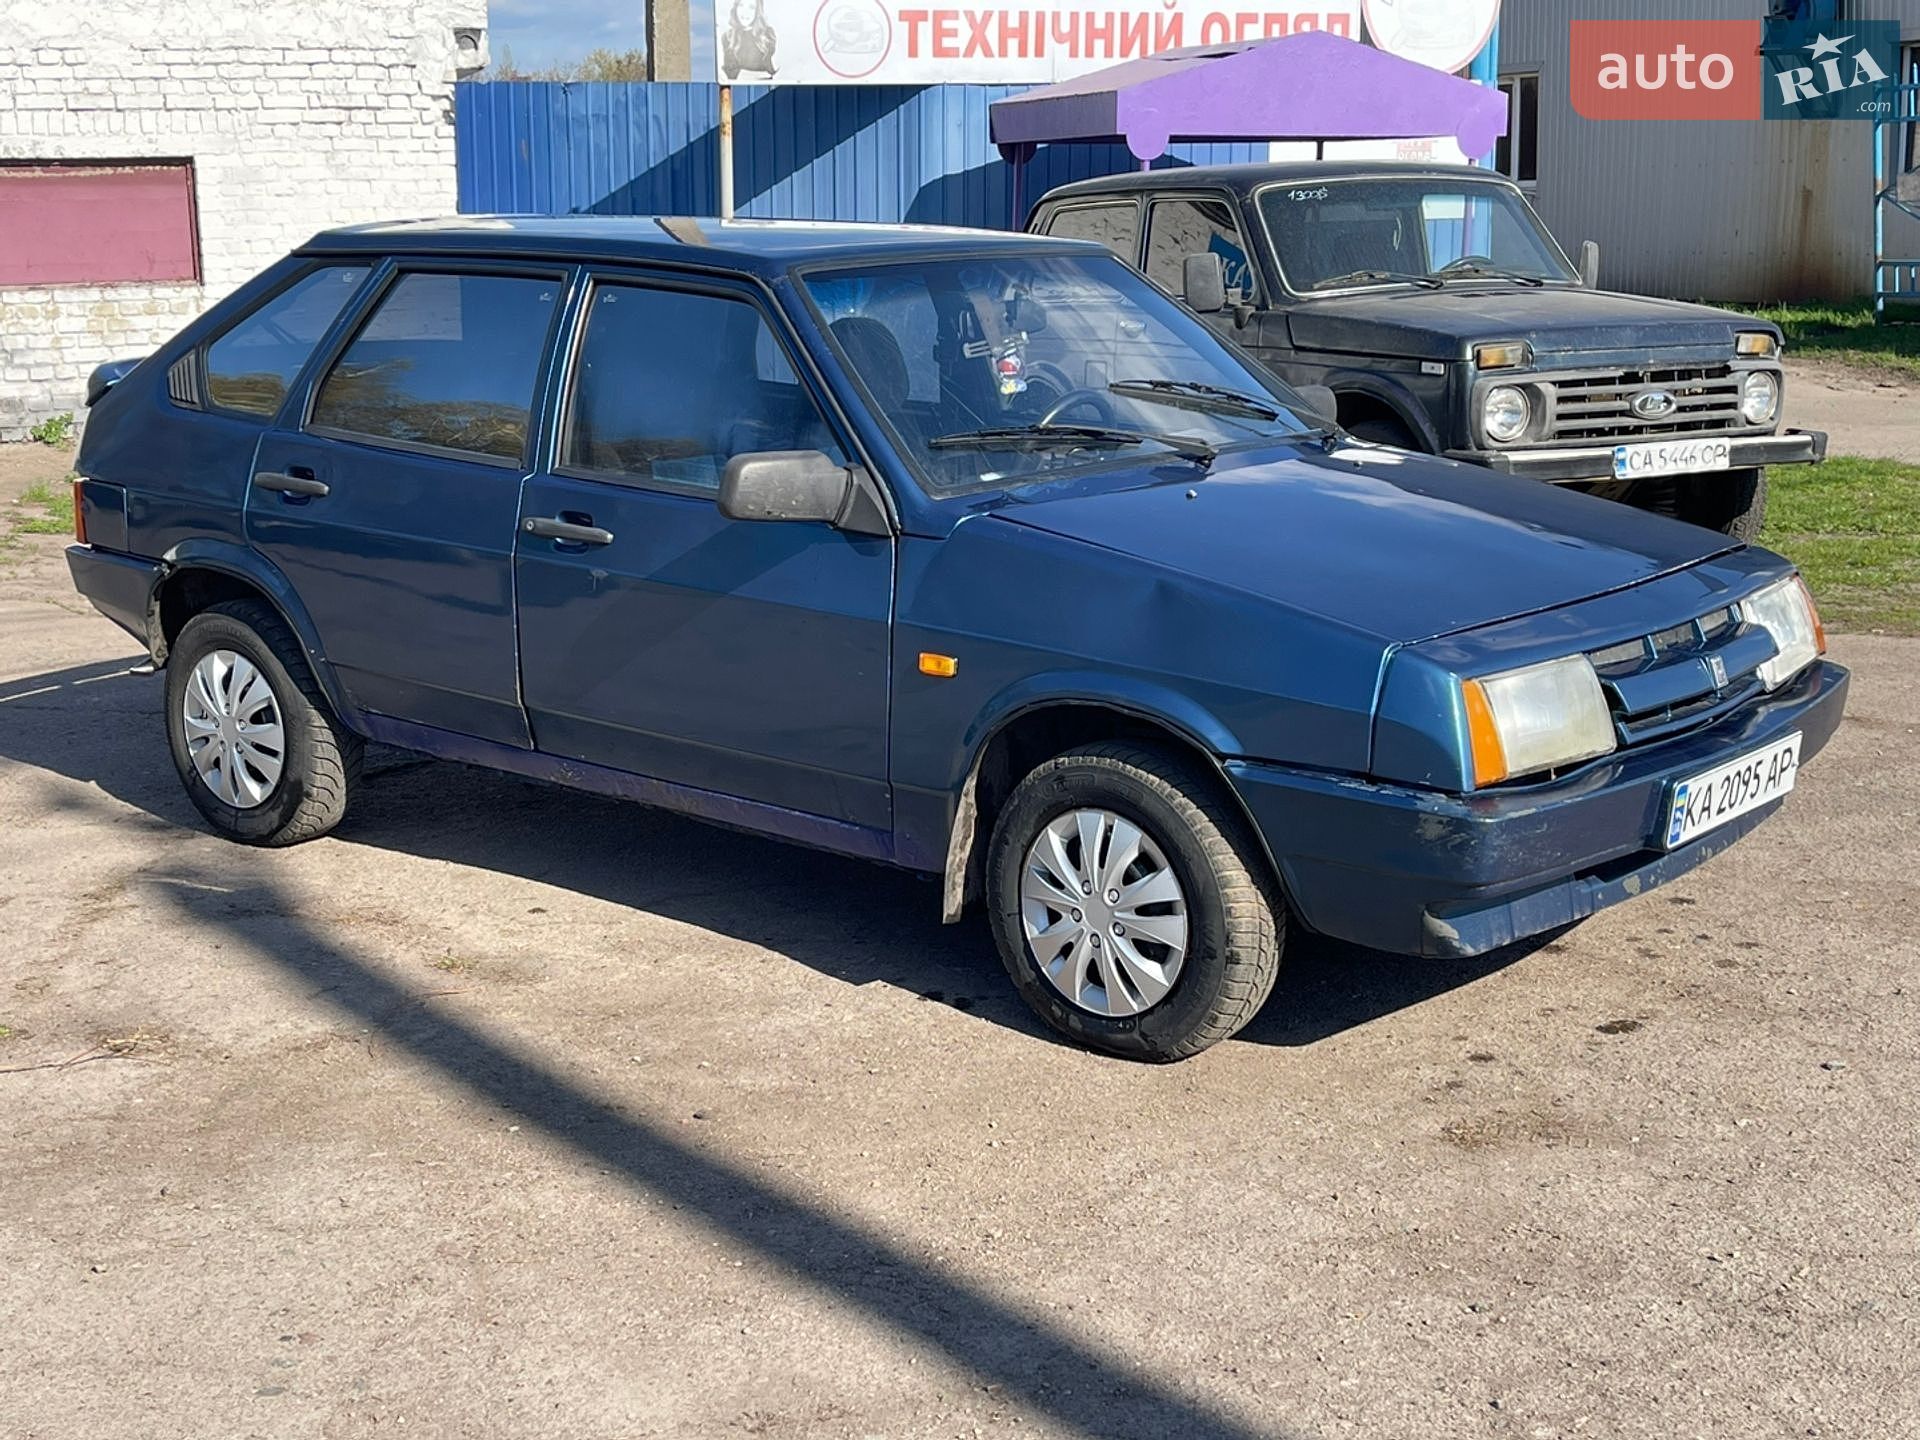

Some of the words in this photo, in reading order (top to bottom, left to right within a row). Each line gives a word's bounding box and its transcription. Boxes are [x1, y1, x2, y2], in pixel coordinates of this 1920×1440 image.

[898, 0, 1184, 58] ТЕХНІЧНИЙ
[1629, 450, 1653, 471] CA
[1659, 445, 1697, 469] 5446
[1683, 782, 1713, 832] KA
[1716, 759, 1764, 815] 2095
[1764, 747, 1793, 793] AP
